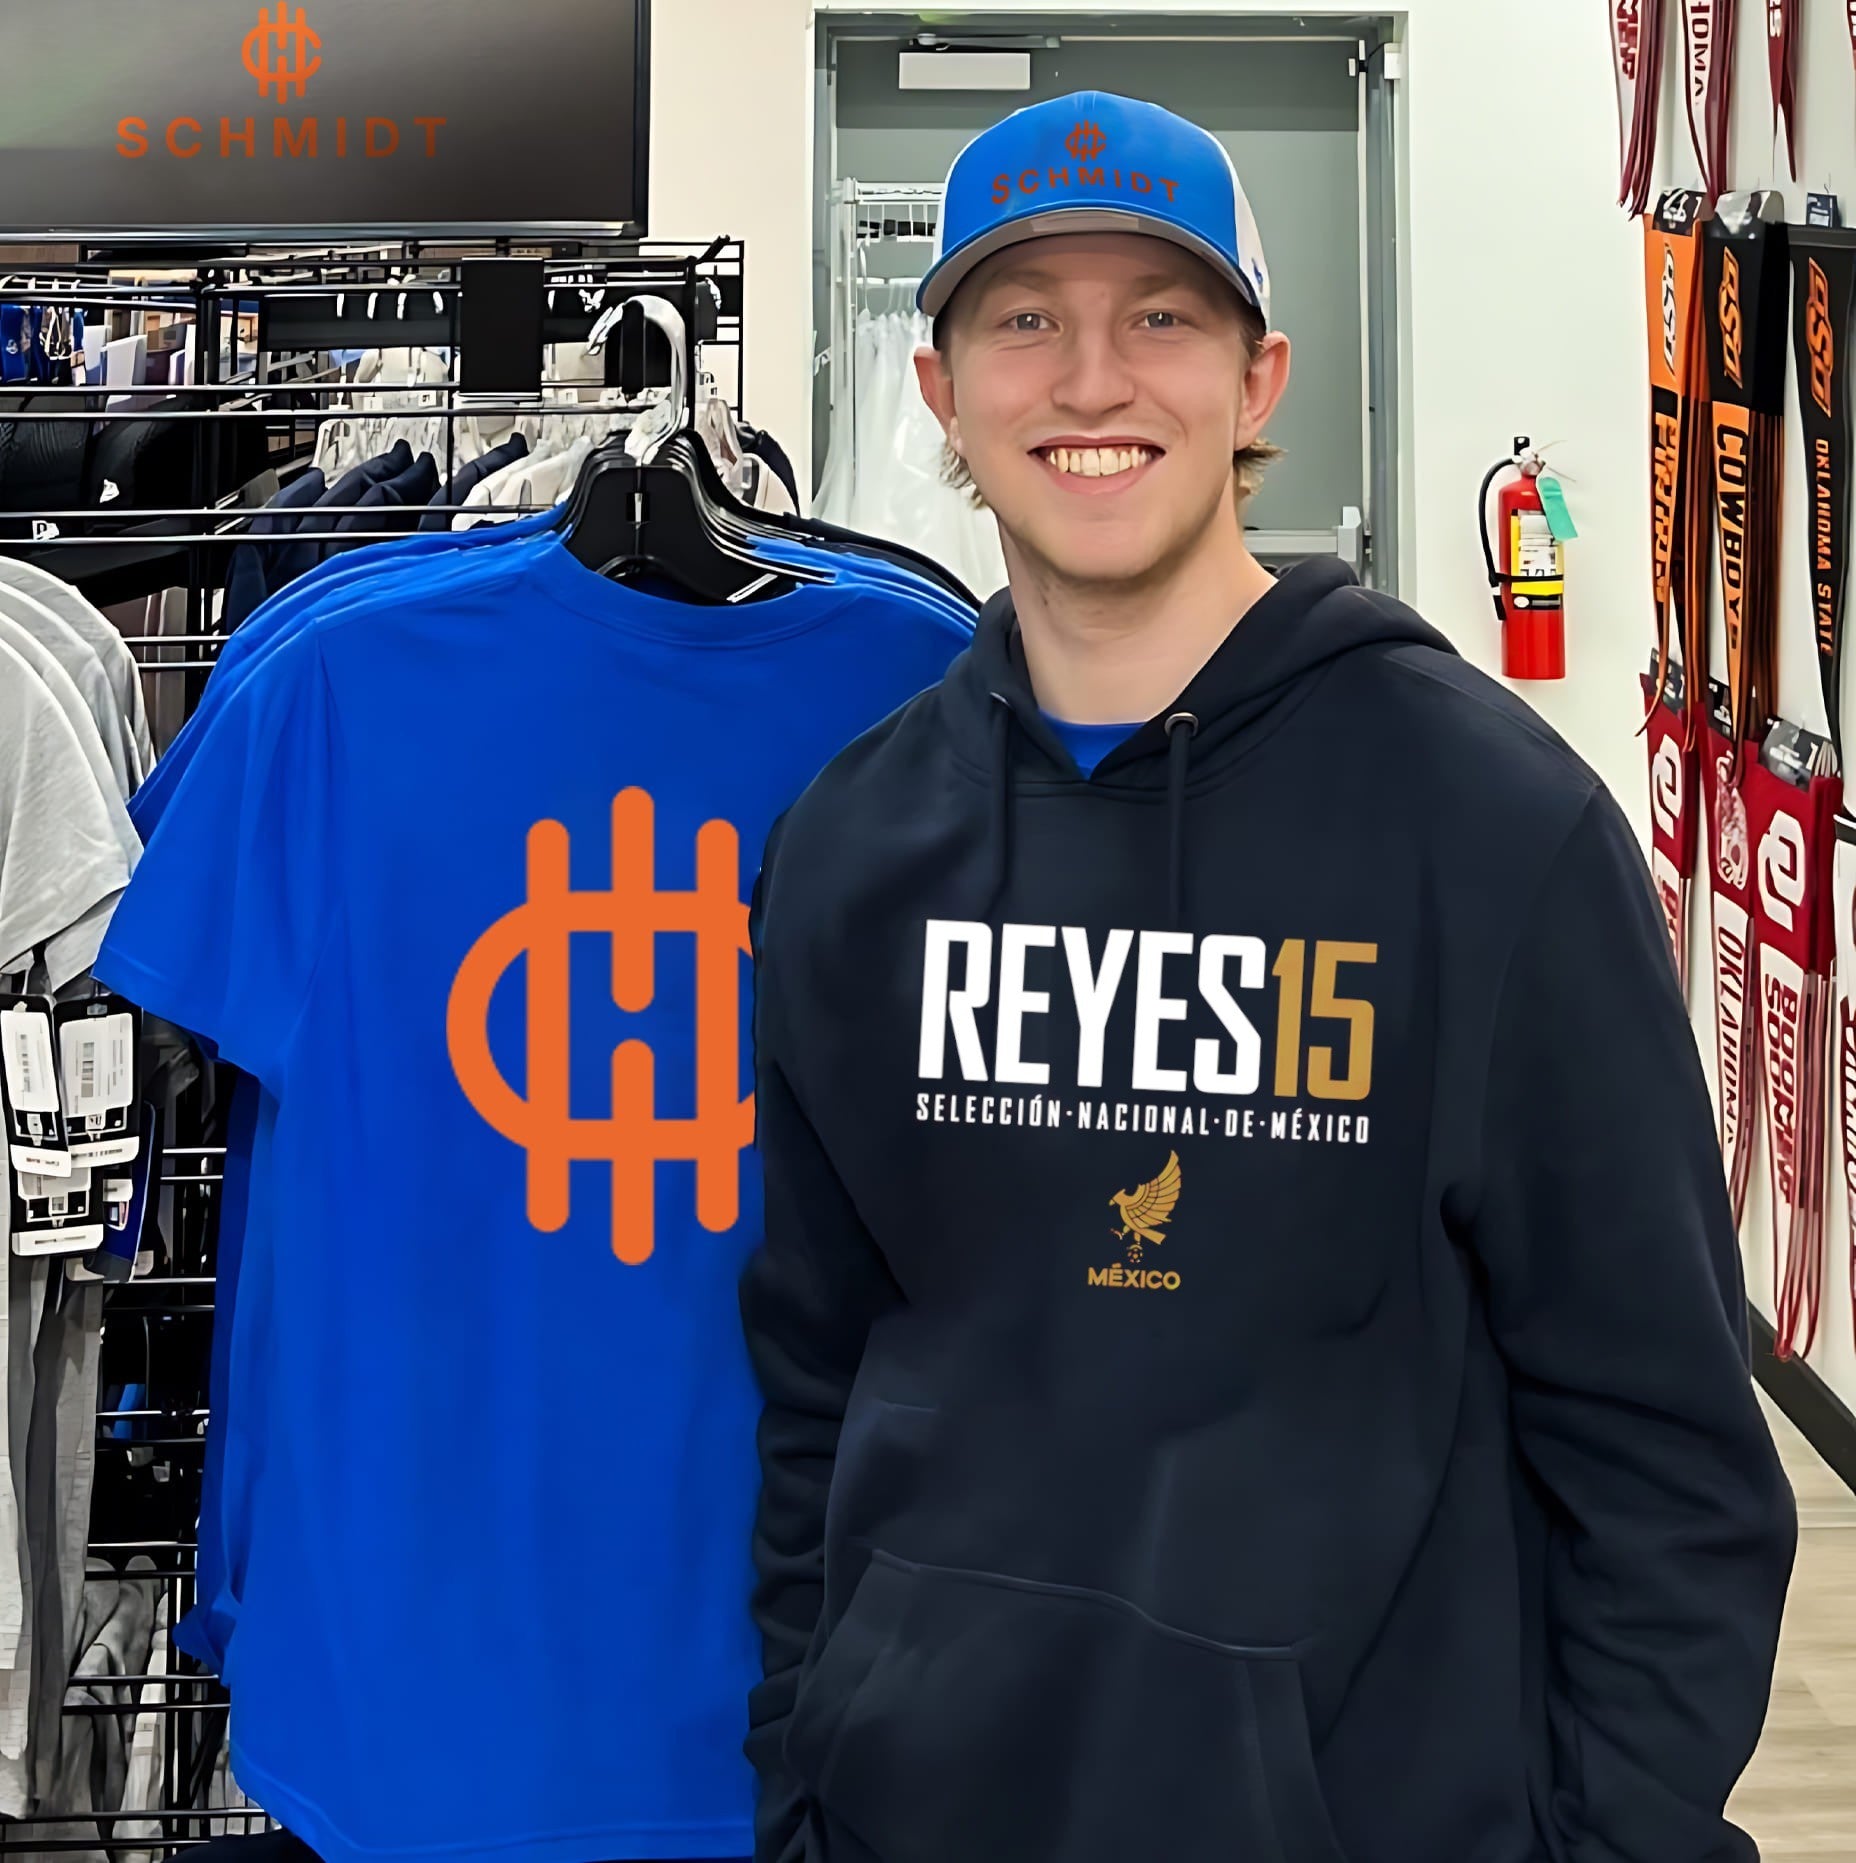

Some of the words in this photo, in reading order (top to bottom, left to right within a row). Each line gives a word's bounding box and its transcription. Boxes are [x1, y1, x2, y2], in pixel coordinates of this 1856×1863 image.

[115, 115, 449, 159] SCHMIDT
[992, 166, 1179, 205] SCHMIDT
[1814, 438, 1833, 571] OKLAHOMA
[1087, 1263, 1181, 1290] MÉXICO
